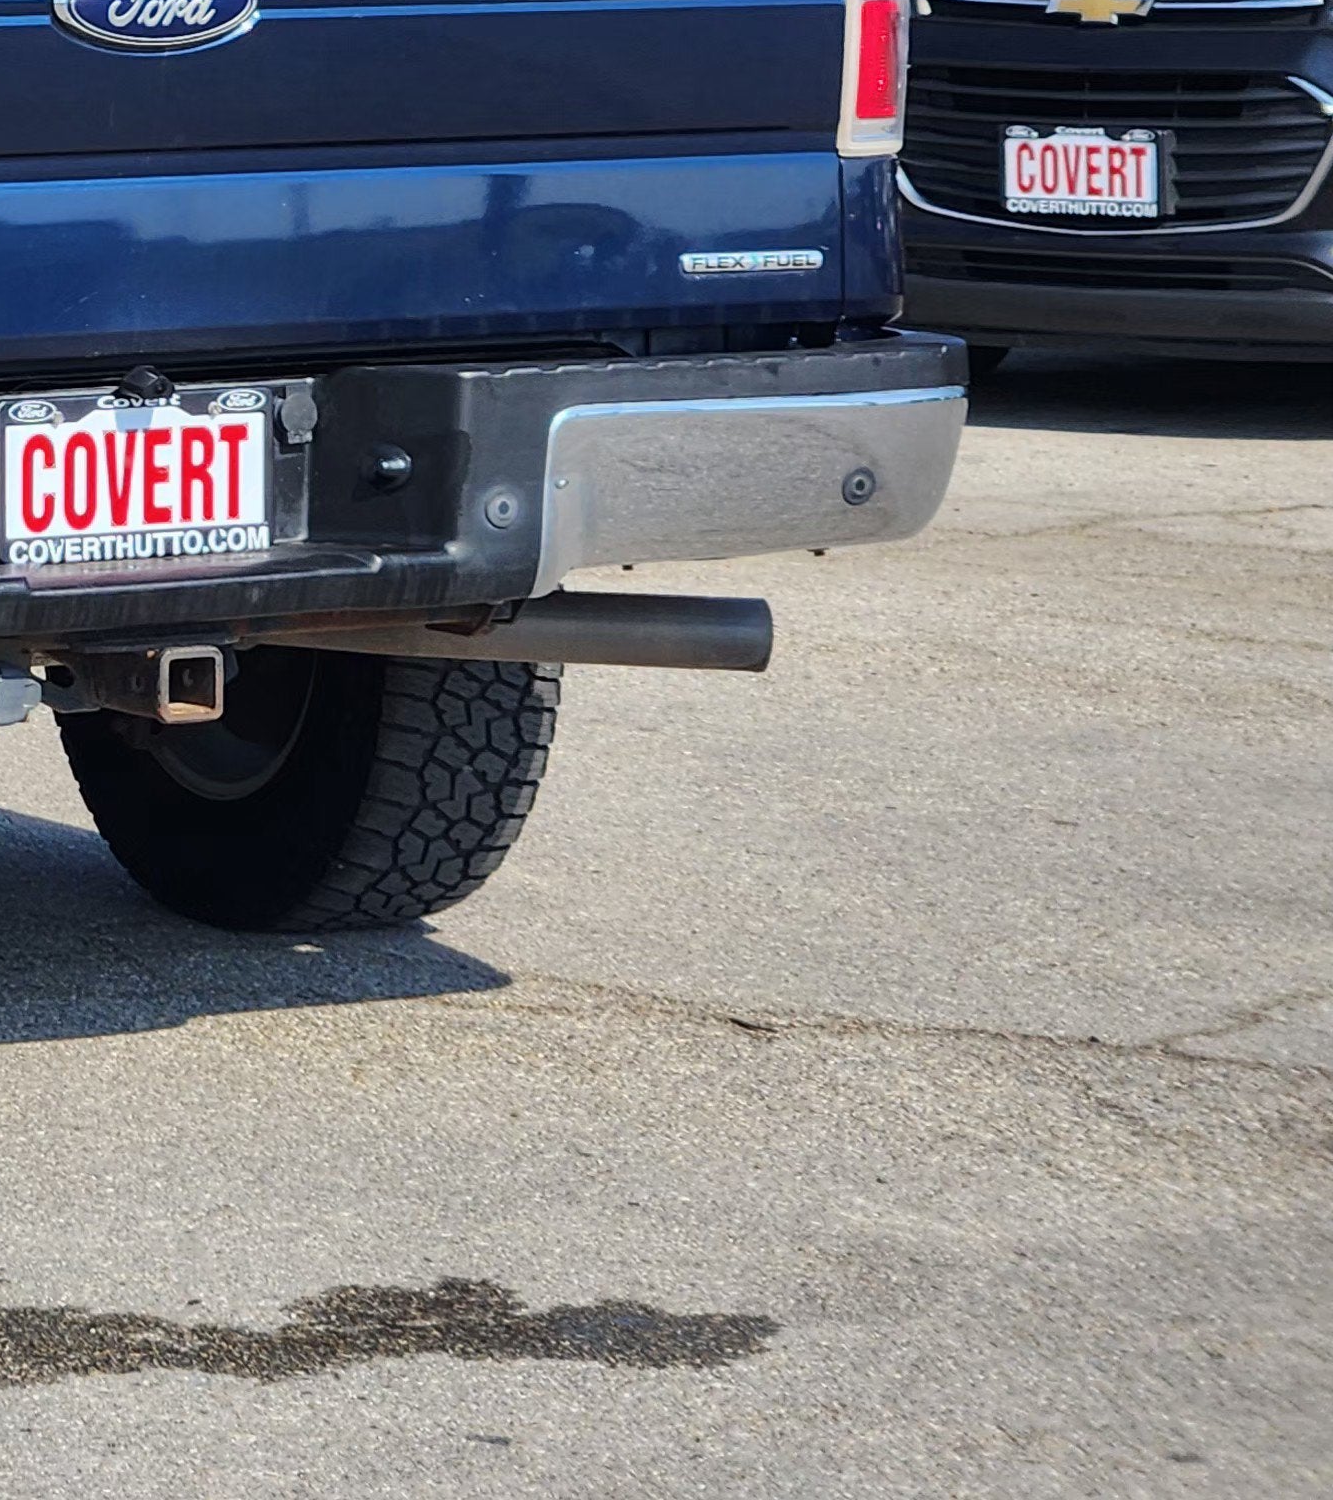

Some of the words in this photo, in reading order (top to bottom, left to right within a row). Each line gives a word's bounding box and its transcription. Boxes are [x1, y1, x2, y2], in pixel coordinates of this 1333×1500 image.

[1016, 141, 1148, 197] COVERT
[1006, 199, 1158, 218] COVERTHUTTO.COM
[691, 256, 745, 269] FLEX
[763, 254, 817, 267] FUEL
[22, 423, 248, 533] COVERT
[9, 526, 271, 564] COVERTHUTTO.COM
